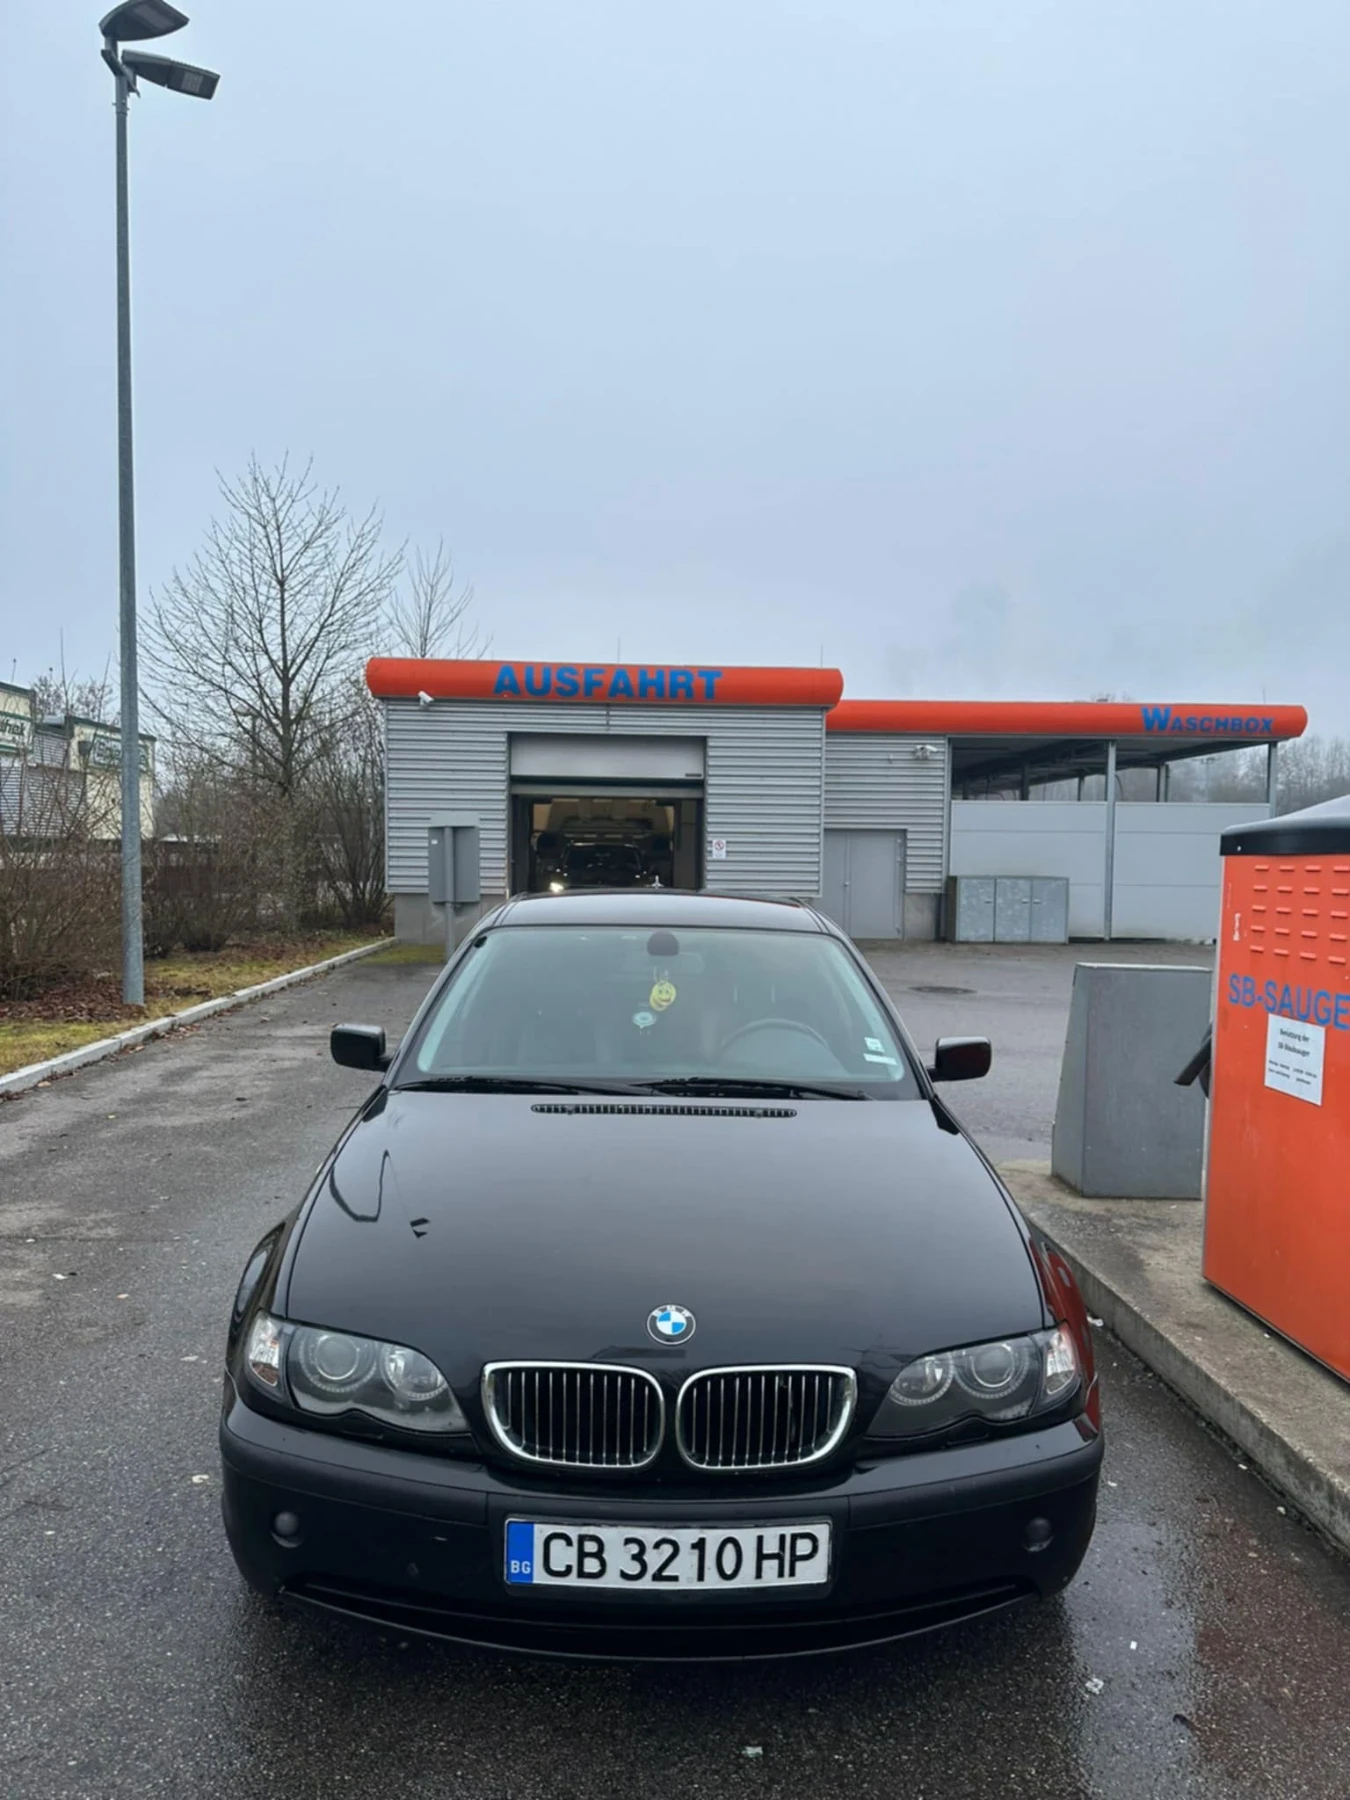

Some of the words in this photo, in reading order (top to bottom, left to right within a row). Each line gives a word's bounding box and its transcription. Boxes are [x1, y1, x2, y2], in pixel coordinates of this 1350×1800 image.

[493, 664, 722, 700] AUSFAHRT
[510, 1560, 531, 1574] BG
[542, 1532, 607, 1579] CB
[619, 1536, 743, 1582] 3210
[755, 1532, 819, 1580] HP
